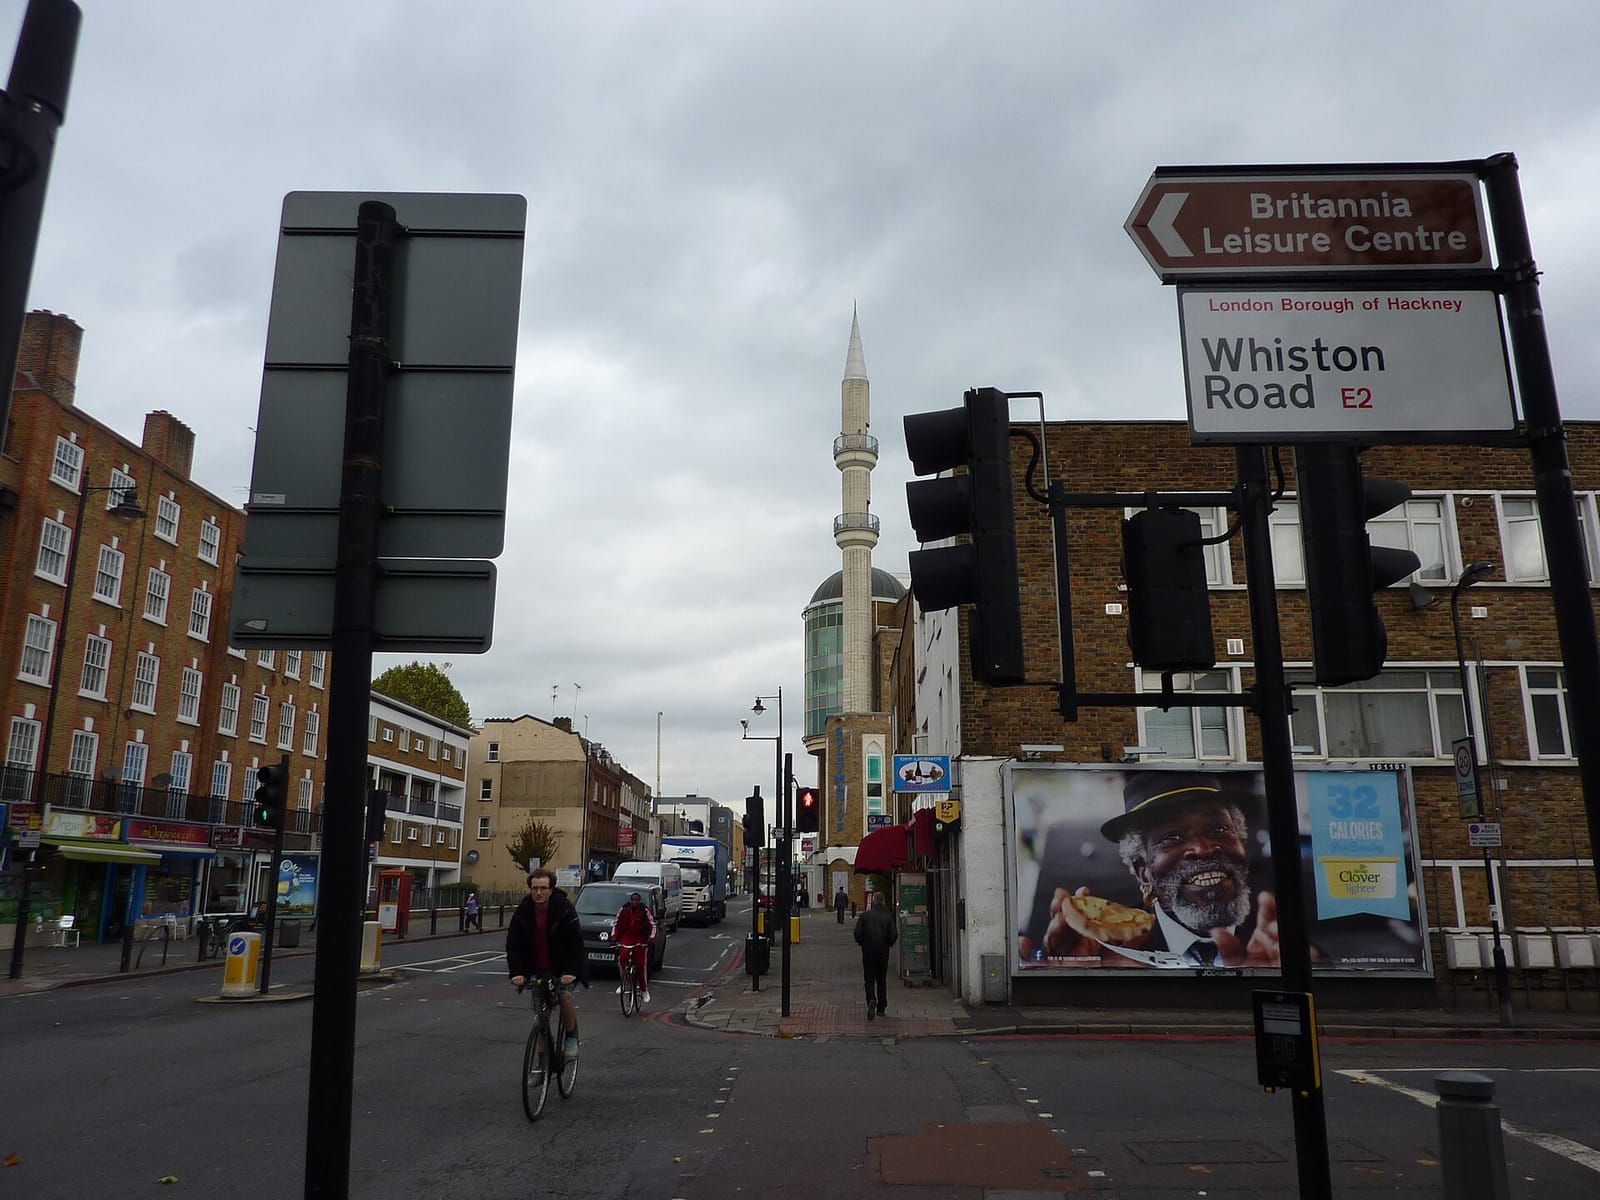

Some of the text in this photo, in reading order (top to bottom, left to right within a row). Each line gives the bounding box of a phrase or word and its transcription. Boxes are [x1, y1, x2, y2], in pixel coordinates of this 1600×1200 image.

[1250, 191, 1413, 219] Britannia
[1203, 225, 1467, 254] Leisure Centre
[1209, 297, 1462, 314] London Borough of Hackney
[1201, 337, 1385, 372] Whiston
[1204, 374, 1373, 410] Road E2
[1460, 755, 1469, 769] 20
[1460, 781, 1474, 791] ZONE
[1328, 784, 1380, 819] 32
[1329, 821, 1384, 840] CALORIES
[1339, 870, 1381, 883] Clover
[1346, 883, 1376, 894] lighter
